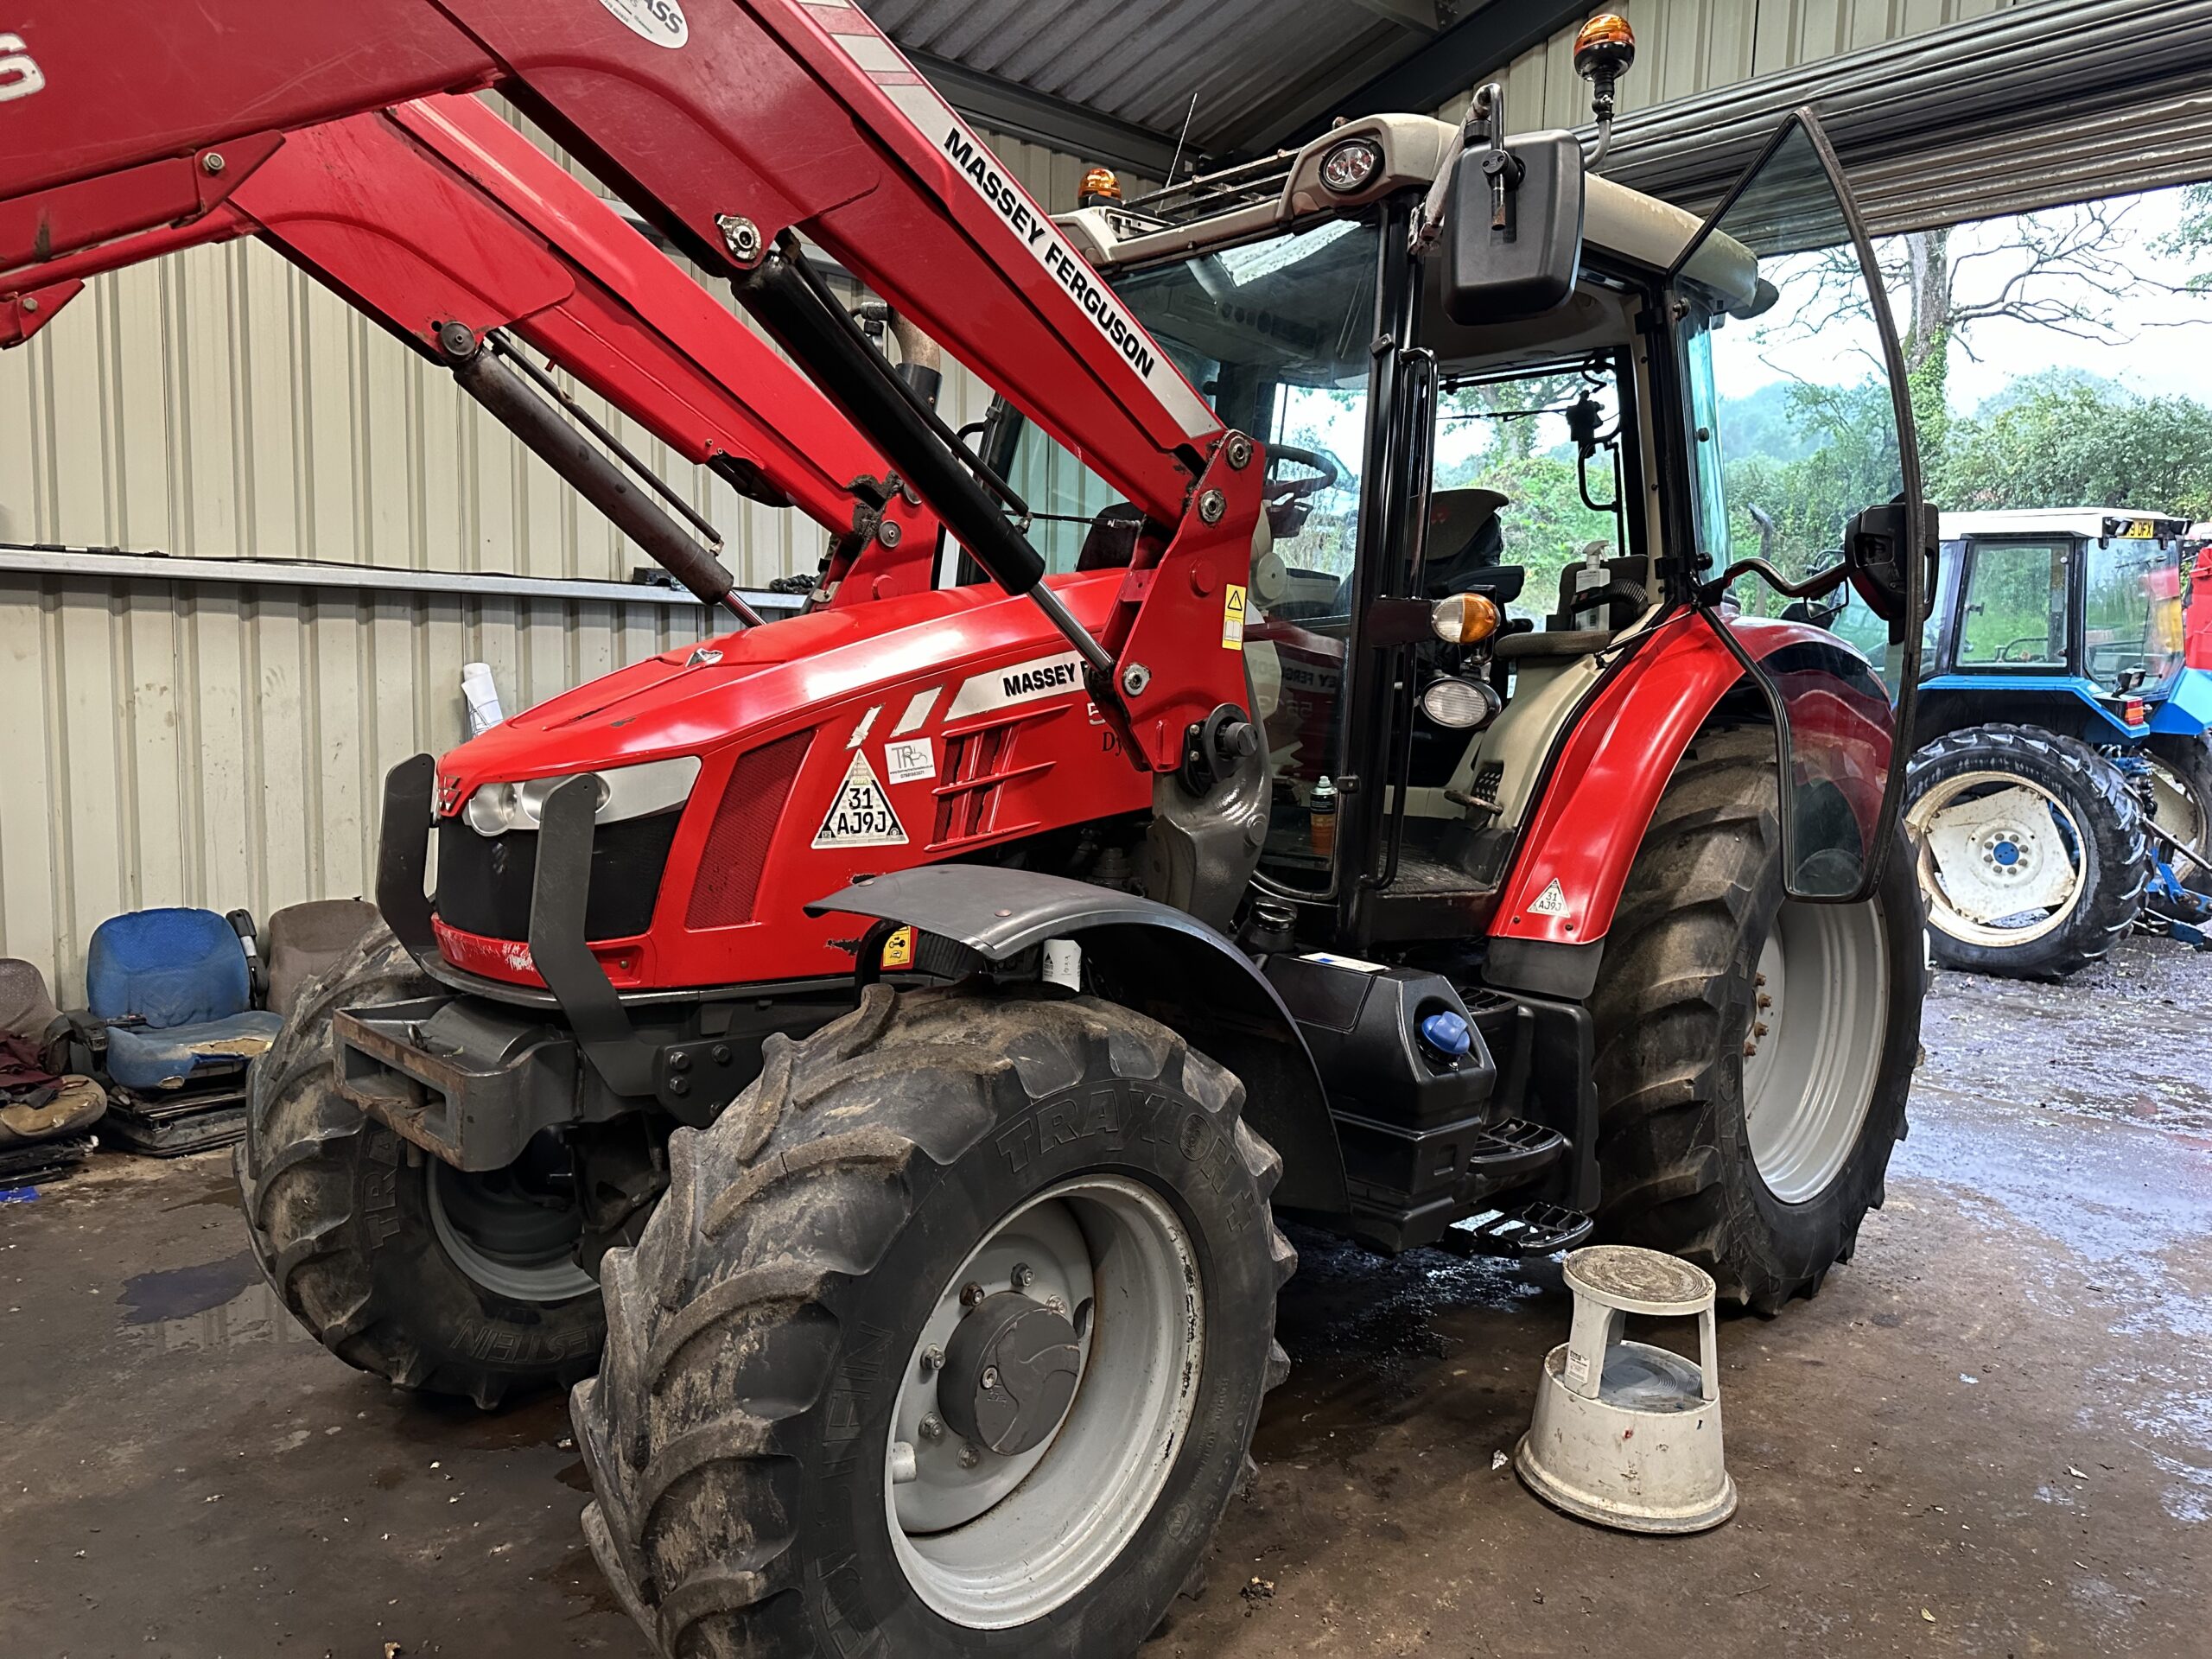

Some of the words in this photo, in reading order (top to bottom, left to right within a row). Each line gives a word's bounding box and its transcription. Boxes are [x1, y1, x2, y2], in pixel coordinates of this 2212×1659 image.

[944, 127, 1046, 245] MASSEY
[1044, 241, 1155, 379] FERGUSON
[1002, 662, 1076, 697] MASSEY
[849, 787, 874, 810] 31
[837, 810, 887, 835] AJ9J
[1538, 900, 1562, 912] AJ9J
[1545, 892, 1558, 902] 31
